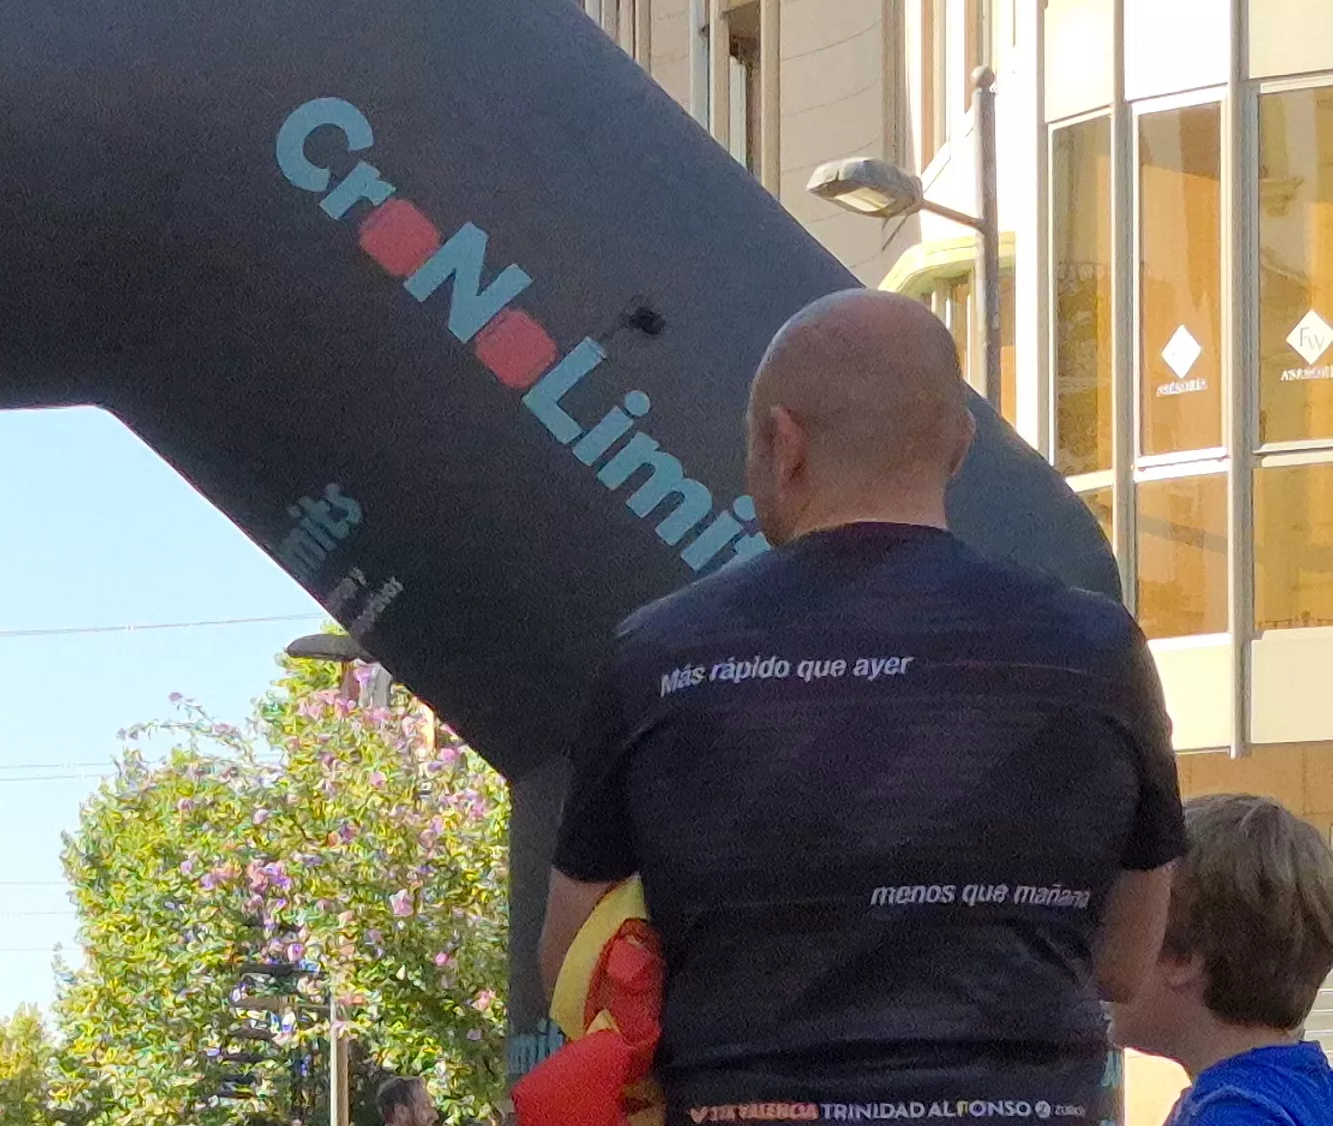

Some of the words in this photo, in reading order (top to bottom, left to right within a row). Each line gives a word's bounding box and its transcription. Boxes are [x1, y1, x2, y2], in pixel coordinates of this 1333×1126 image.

[660, 663, 705, 698] Más
[707, 655, 790, 684] rápido
[796, 658, 848, 683] que
[852, 655, 915, 682] ayer
[870, 884, 957, 906] menos
[962, 883, 1010, 907] que
[820, 1102, 925, 1120] TRINIDAD
[927, 1099, 1033, 1118] ALFONSO
